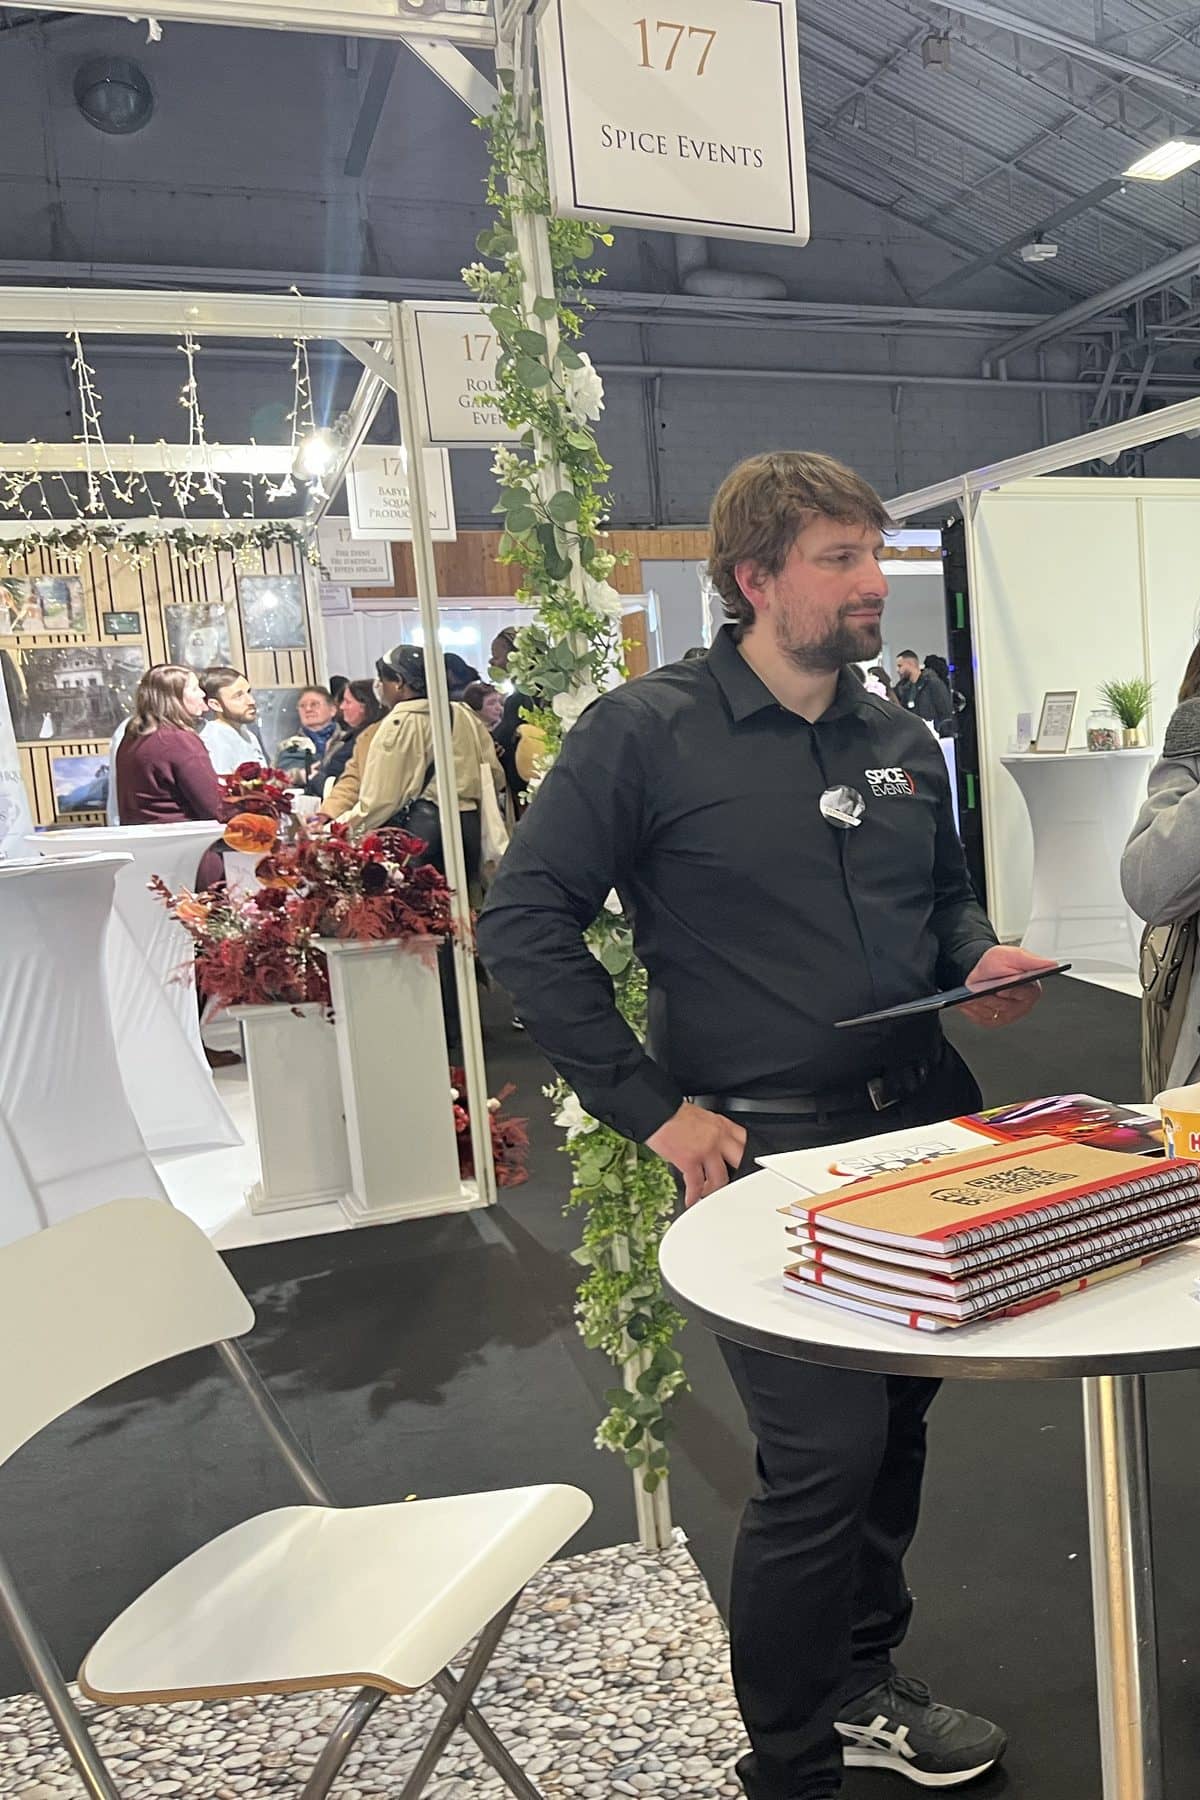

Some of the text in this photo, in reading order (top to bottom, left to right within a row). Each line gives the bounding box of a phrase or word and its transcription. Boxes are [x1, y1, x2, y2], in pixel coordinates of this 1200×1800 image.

[632, 18, 717, 76] 177
[601, 124, 764, 169] SPICE EVENTS
[466, 377, 502, 391] ROU
[382, 457, 401, 476] 17
[377, 486, 408, 497] BABYL
[382, 497, 410, 510] SQUA
[865, 767, 908, 785] SPICE
[872, 783, 913, 797] EVENTS
